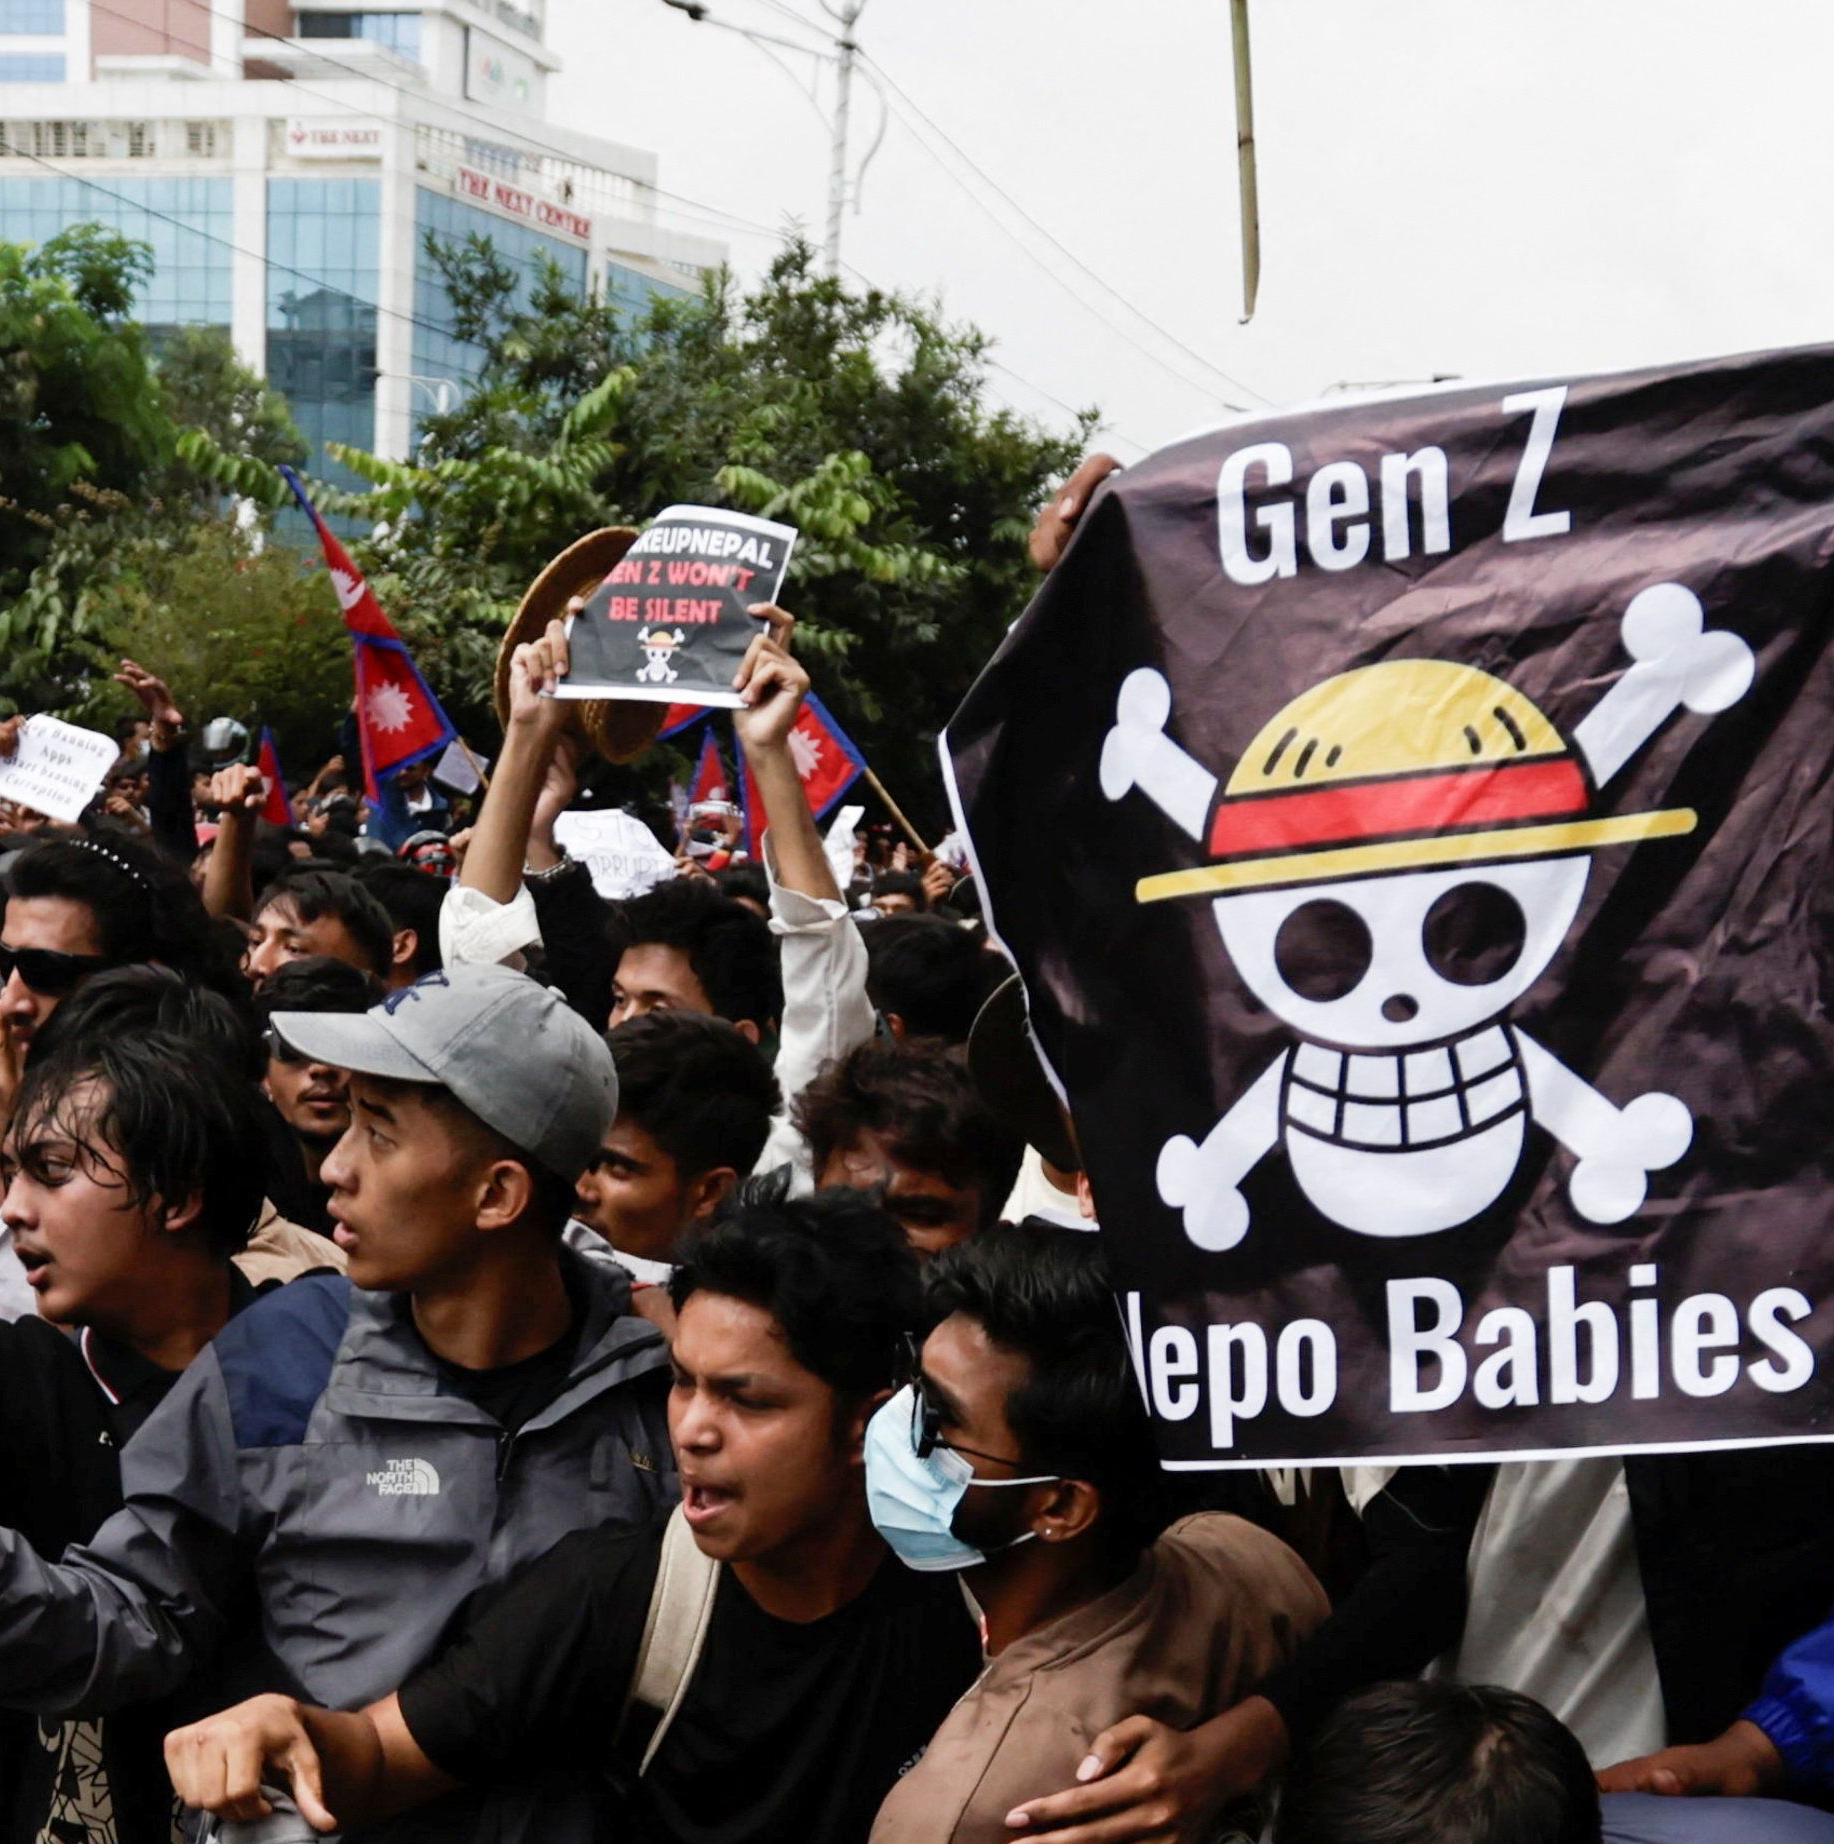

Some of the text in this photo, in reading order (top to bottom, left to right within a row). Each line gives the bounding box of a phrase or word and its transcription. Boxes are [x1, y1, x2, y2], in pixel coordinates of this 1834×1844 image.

[459, 167, 592, 239] THE NEXT CENTRE
[1216, 385, 1571, 586] Gen Z
[647, 559, 663, 586] Z
[667, 561, 757, 592] WON'T
[608, 596, 723, 624] BE SILENT
[40, 745, 73, 766] Apps
[1386, 1263, 1815, 1413] Babies
[366, 1471, 413, 1486] NORTH
[386, 1458, 413, 1472] THE
[378, 1483, 414, 1496] FACE
